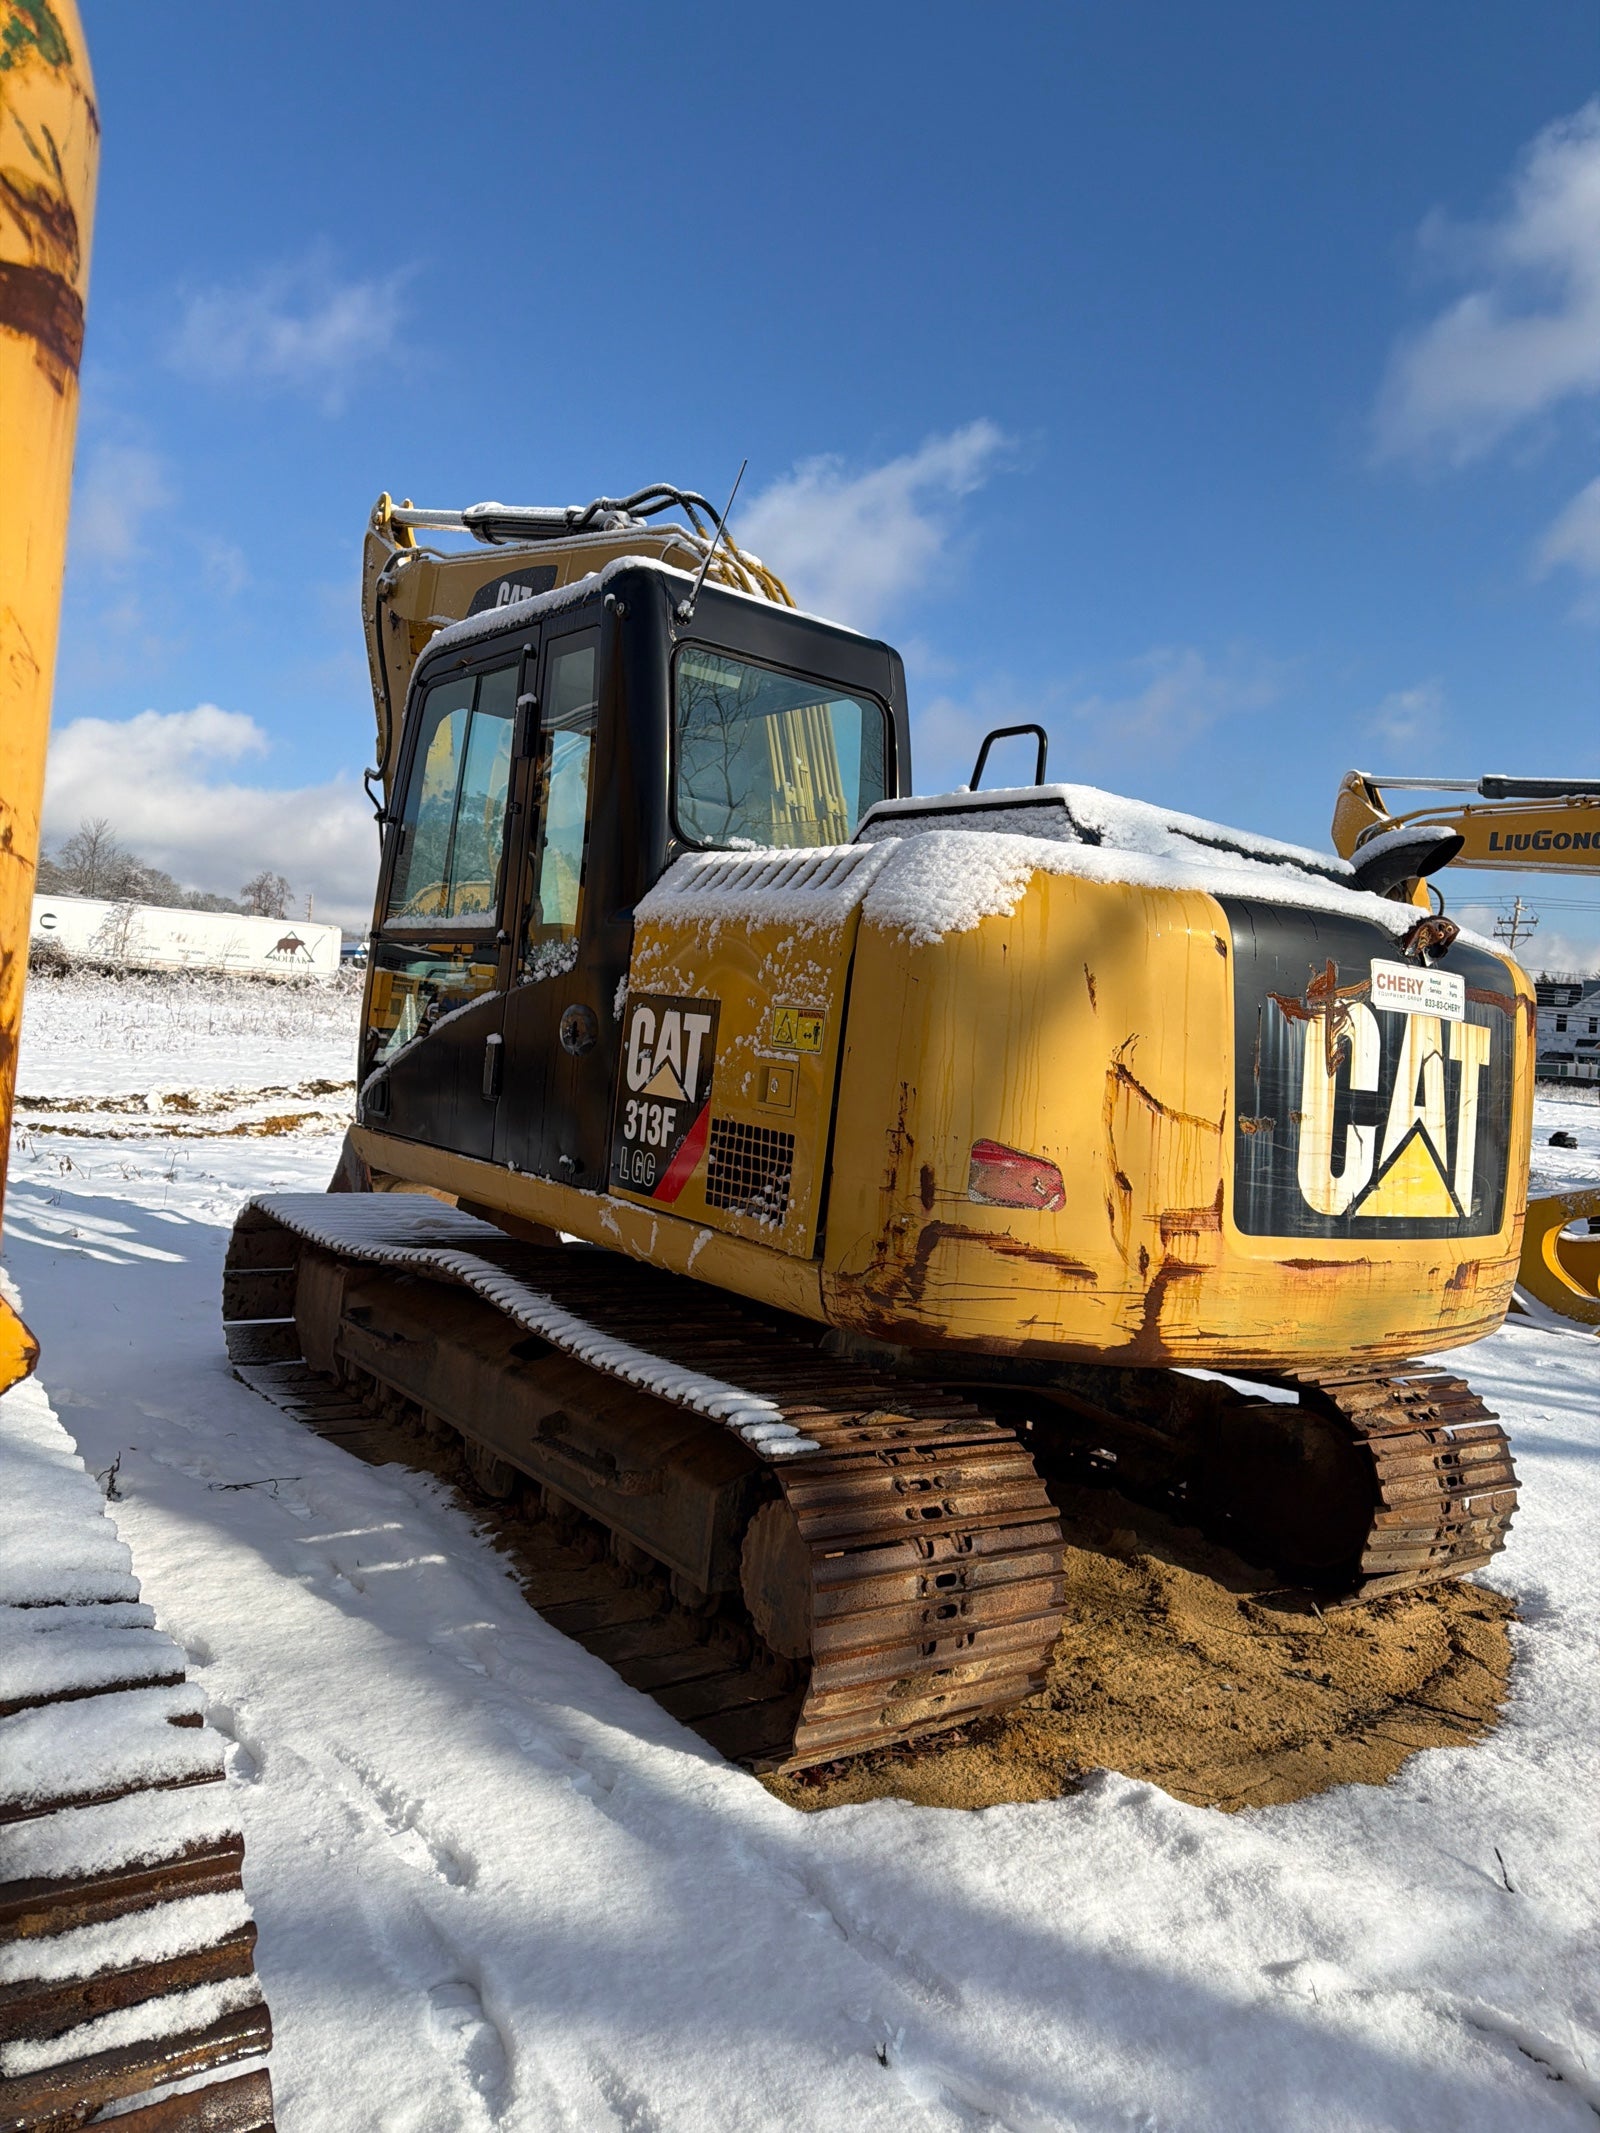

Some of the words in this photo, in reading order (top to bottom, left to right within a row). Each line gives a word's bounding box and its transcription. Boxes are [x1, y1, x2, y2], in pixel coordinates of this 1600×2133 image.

[1376, 972, 1424, 995] CHERY
[1378, 991, 1406, 999] EQUIPMENT
[1424, 998, 1461, 1013] 833-83-CHERY
[626, 1006, 712, 1103] CAT
[623, 1099, 677, 1148] 313F
[1297, 998, 1491, 1218] CAT
